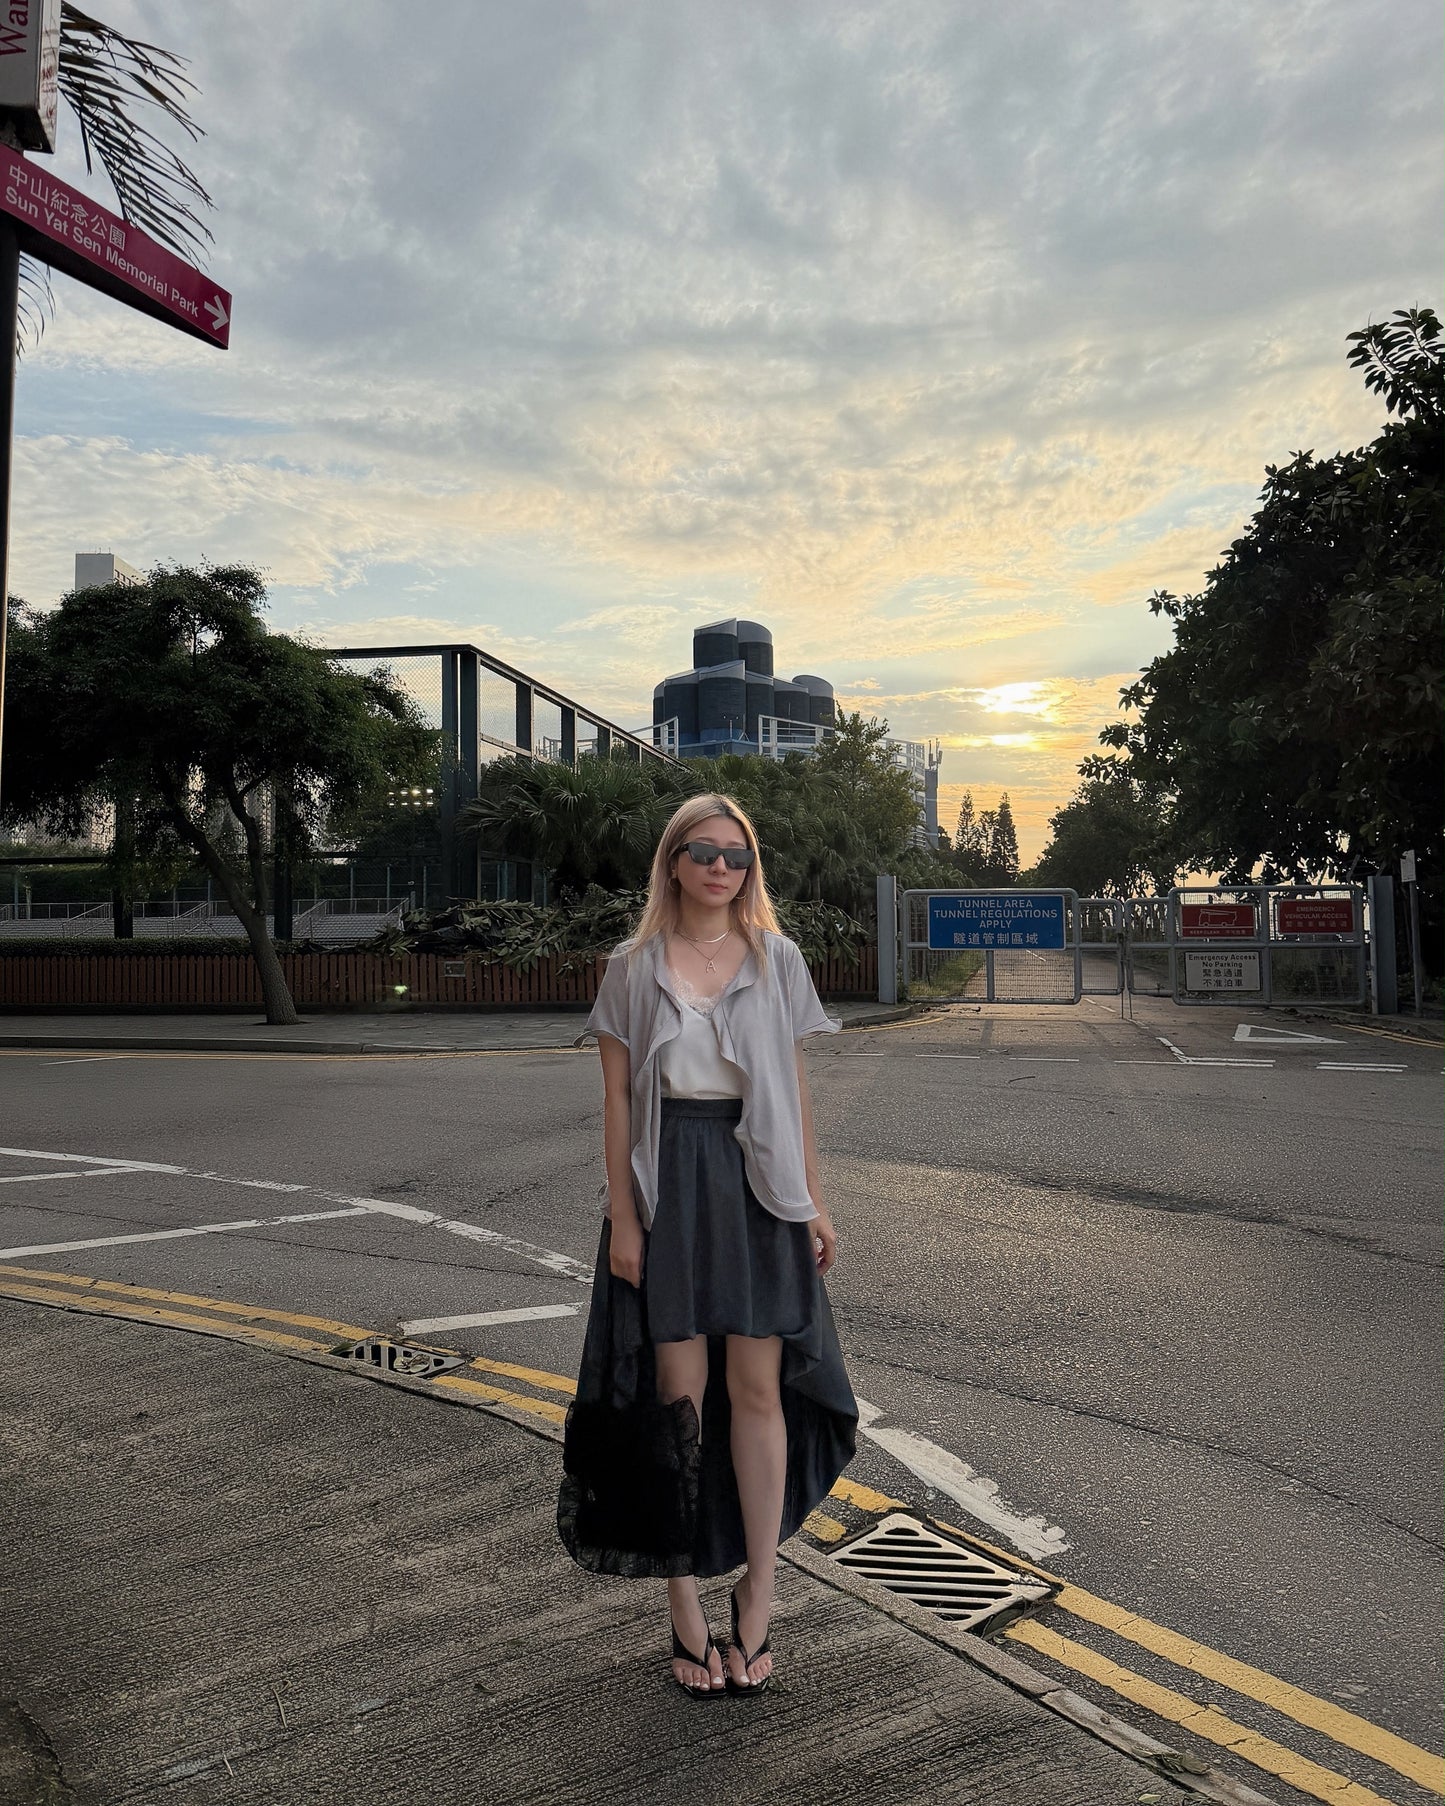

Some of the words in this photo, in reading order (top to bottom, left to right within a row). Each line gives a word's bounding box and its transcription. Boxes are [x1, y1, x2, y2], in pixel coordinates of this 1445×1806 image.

[0, 0, 28, 55] Wa
[9, 164, 126, 252] 中山紀念公園
[5, 186, 39, 219] Sun
[43, 208, 69, 236] Yat
[72, 227, 102, 256] Sen
[106, 247, 168, 297] Memorial
[171, 287, 199, 318] Park
[957, 899, 1002, 909] TUNNEL
[1004, 899, 1033, 909] AREA
[934, 909, 980, 919] TUNNEL
[980, 909, 1058, 919] REGULATIONS
[979, 919, 1012, 929] APPLY
[953, 932, 1039, 945] 隧道管制區域
[1202, 978, 1243, 988] 不准泊車
